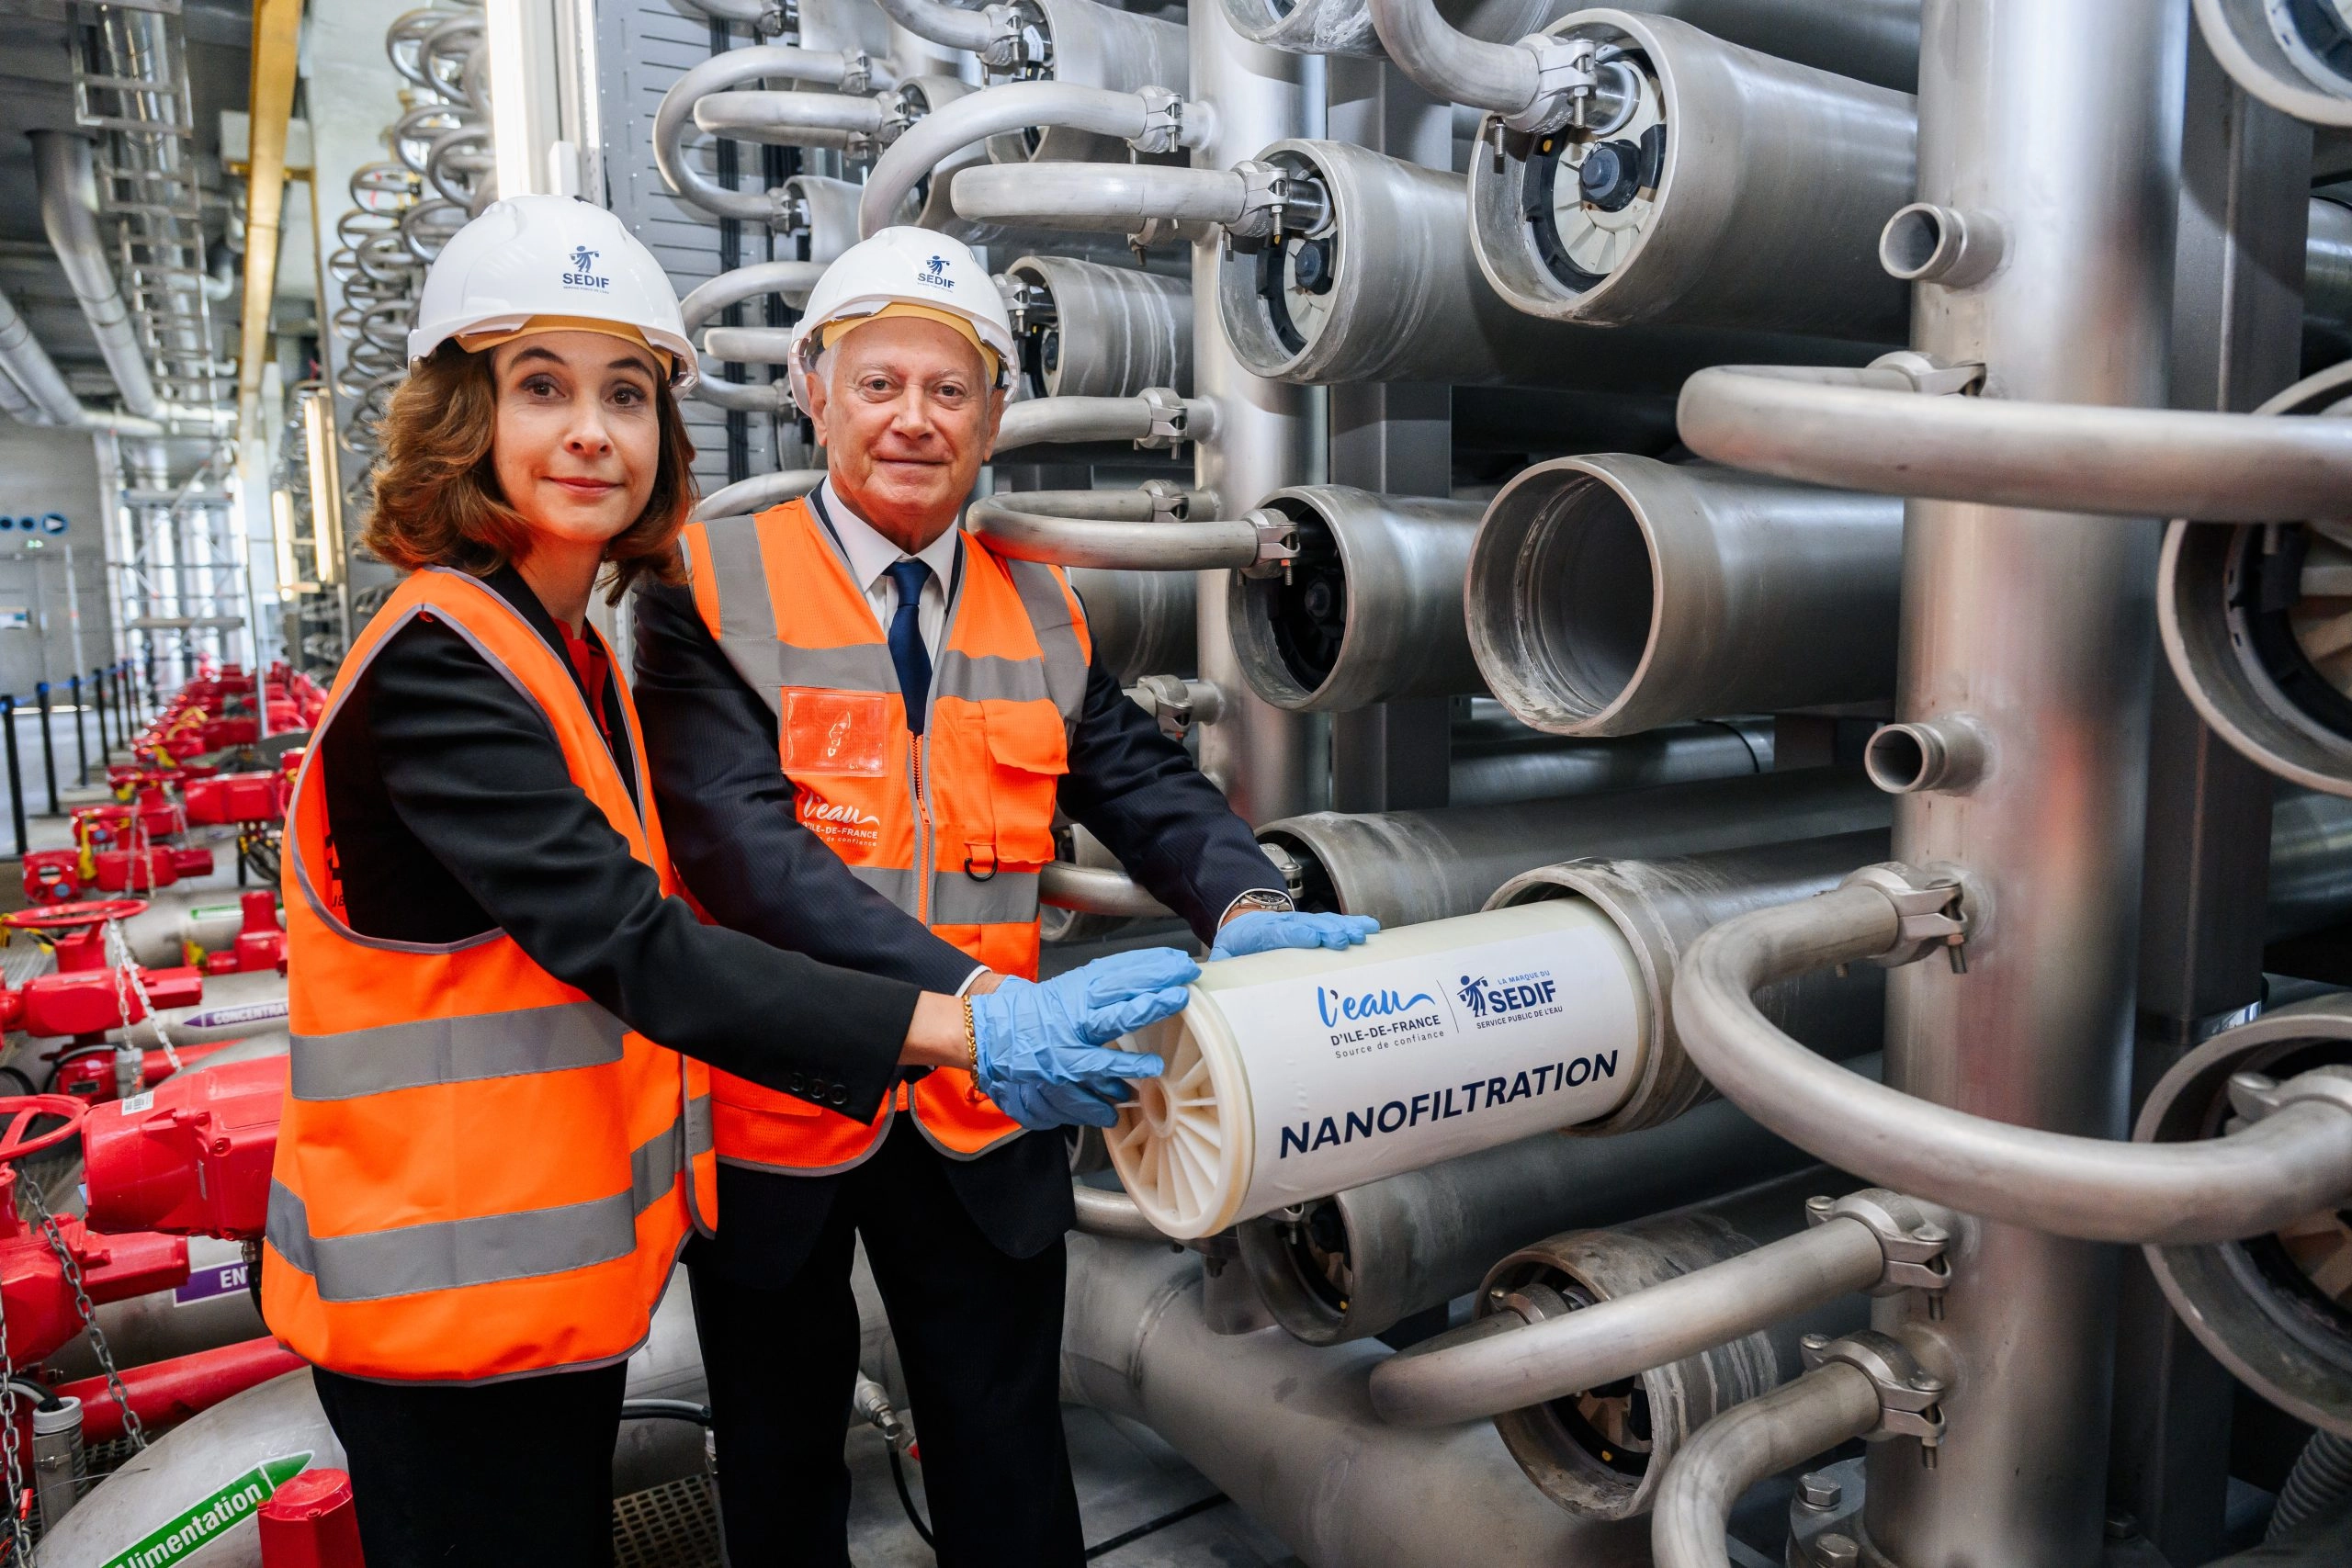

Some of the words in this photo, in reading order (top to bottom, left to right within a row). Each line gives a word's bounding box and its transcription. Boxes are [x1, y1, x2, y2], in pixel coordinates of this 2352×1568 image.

[562, 273, 610, 288] SEDIF
[917, 273, 956, 288] SEDIF
[837, 837, 877, 847] confiance
[1509, 972, 1539, 983] MARQUE
[1317, 986, 1436, 1028] l'eau
[1487, 979, 1556, 1013] SEDIF
[1330, 1014, 1442, 1046] D'ILE-DE-FRANCE
[1476, 1017, 1507, 1030] SERVICE
[1508, 1011, 1533, 1023] PUBLIC
[1533, 1010, 1544, 1018] DE
[1544, 1006, 1563, 1015] L'EAU
[1335, 1044, 1373, 1059] Source
[1377, 1041, 1389, 1050] de
[1394, 1030, 1444, 1046] confiance
[1279, 1049, 1619, 1159] NANOFILTRATION
[220, 1265, 249, 1289] EN
[115, 1483, 264, 1568] limentation
